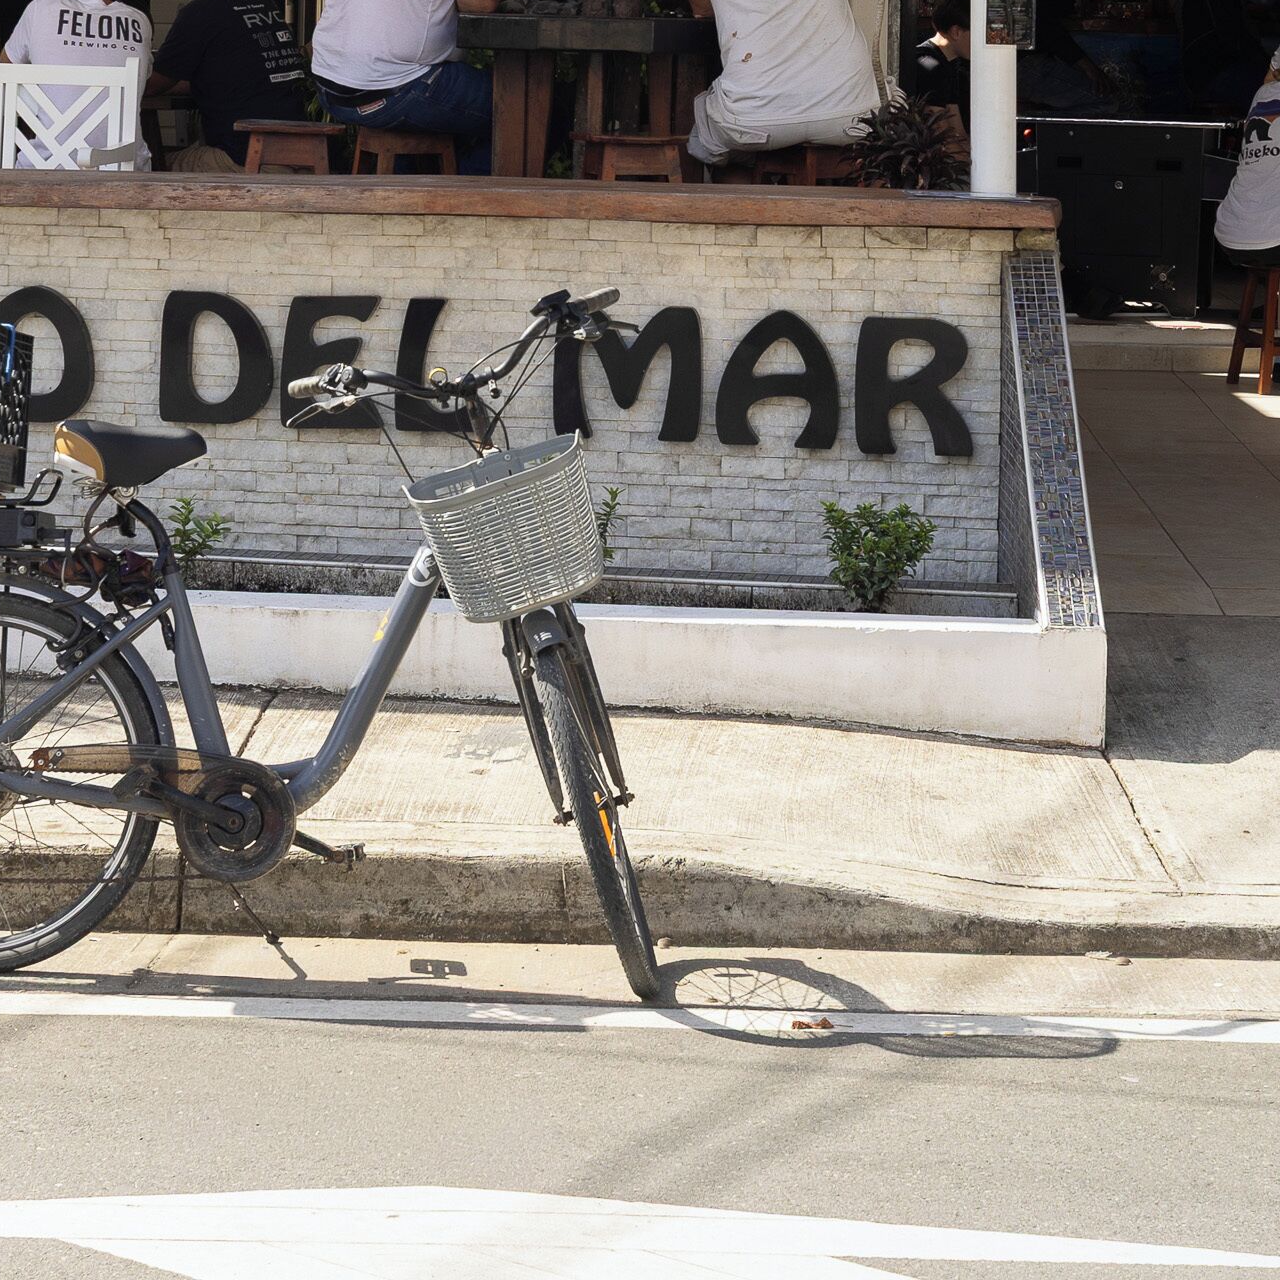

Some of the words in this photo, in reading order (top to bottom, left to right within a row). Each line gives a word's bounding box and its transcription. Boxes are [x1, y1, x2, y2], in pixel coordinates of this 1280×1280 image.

[57, 9, 144, 44] FELONS
[243, 10, 285, 28] RVC
[63, 39, 117, 50] BREWING
[159, 290, 469, 432] DEL
[552, 306, 973, 457] MAR
